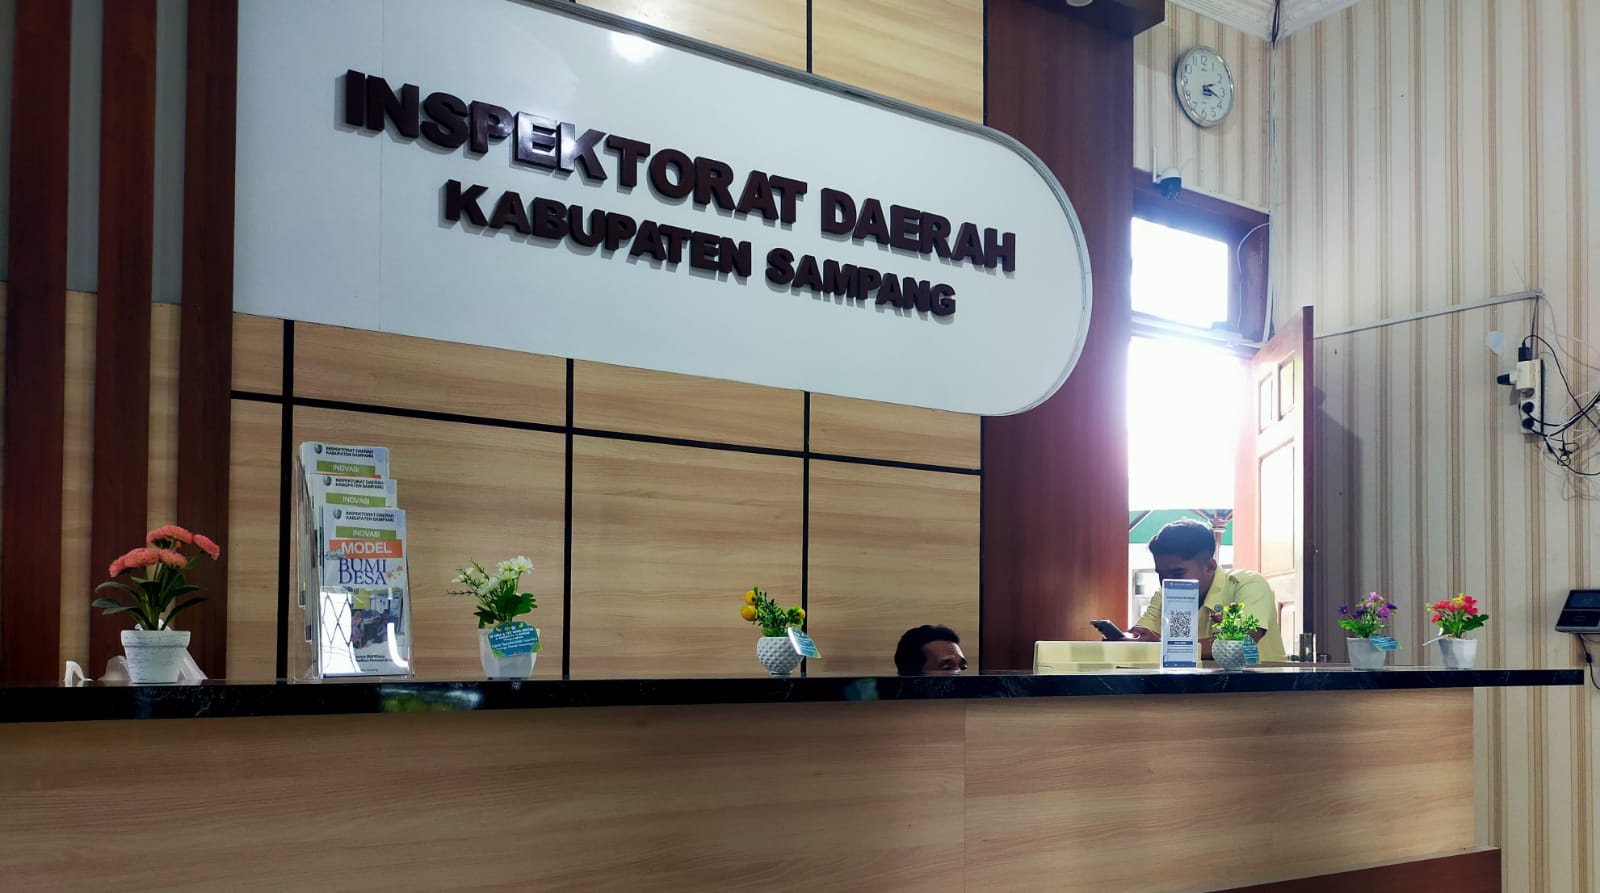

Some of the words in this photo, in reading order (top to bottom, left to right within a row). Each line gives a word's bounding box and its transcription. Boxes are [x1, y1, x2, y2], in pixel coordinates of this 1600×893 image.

[345, 70, 808, 225] INSPEKTORAT
[820, 188, 1017, 272] DAERAH
[443, 179, 752, 278] KABUPATEN
[765, 247, 957, 316] SAMPANG
[332, 463, 360, 473] INOVASI
[342, 495, 370, 505] INOVASI
[352, 529, 380, 538] INOVASI
[341, 541, 392, 554] MODEL
[339, 557, 387, 573] BUMI
[339, 570, 387, 585] DESA
